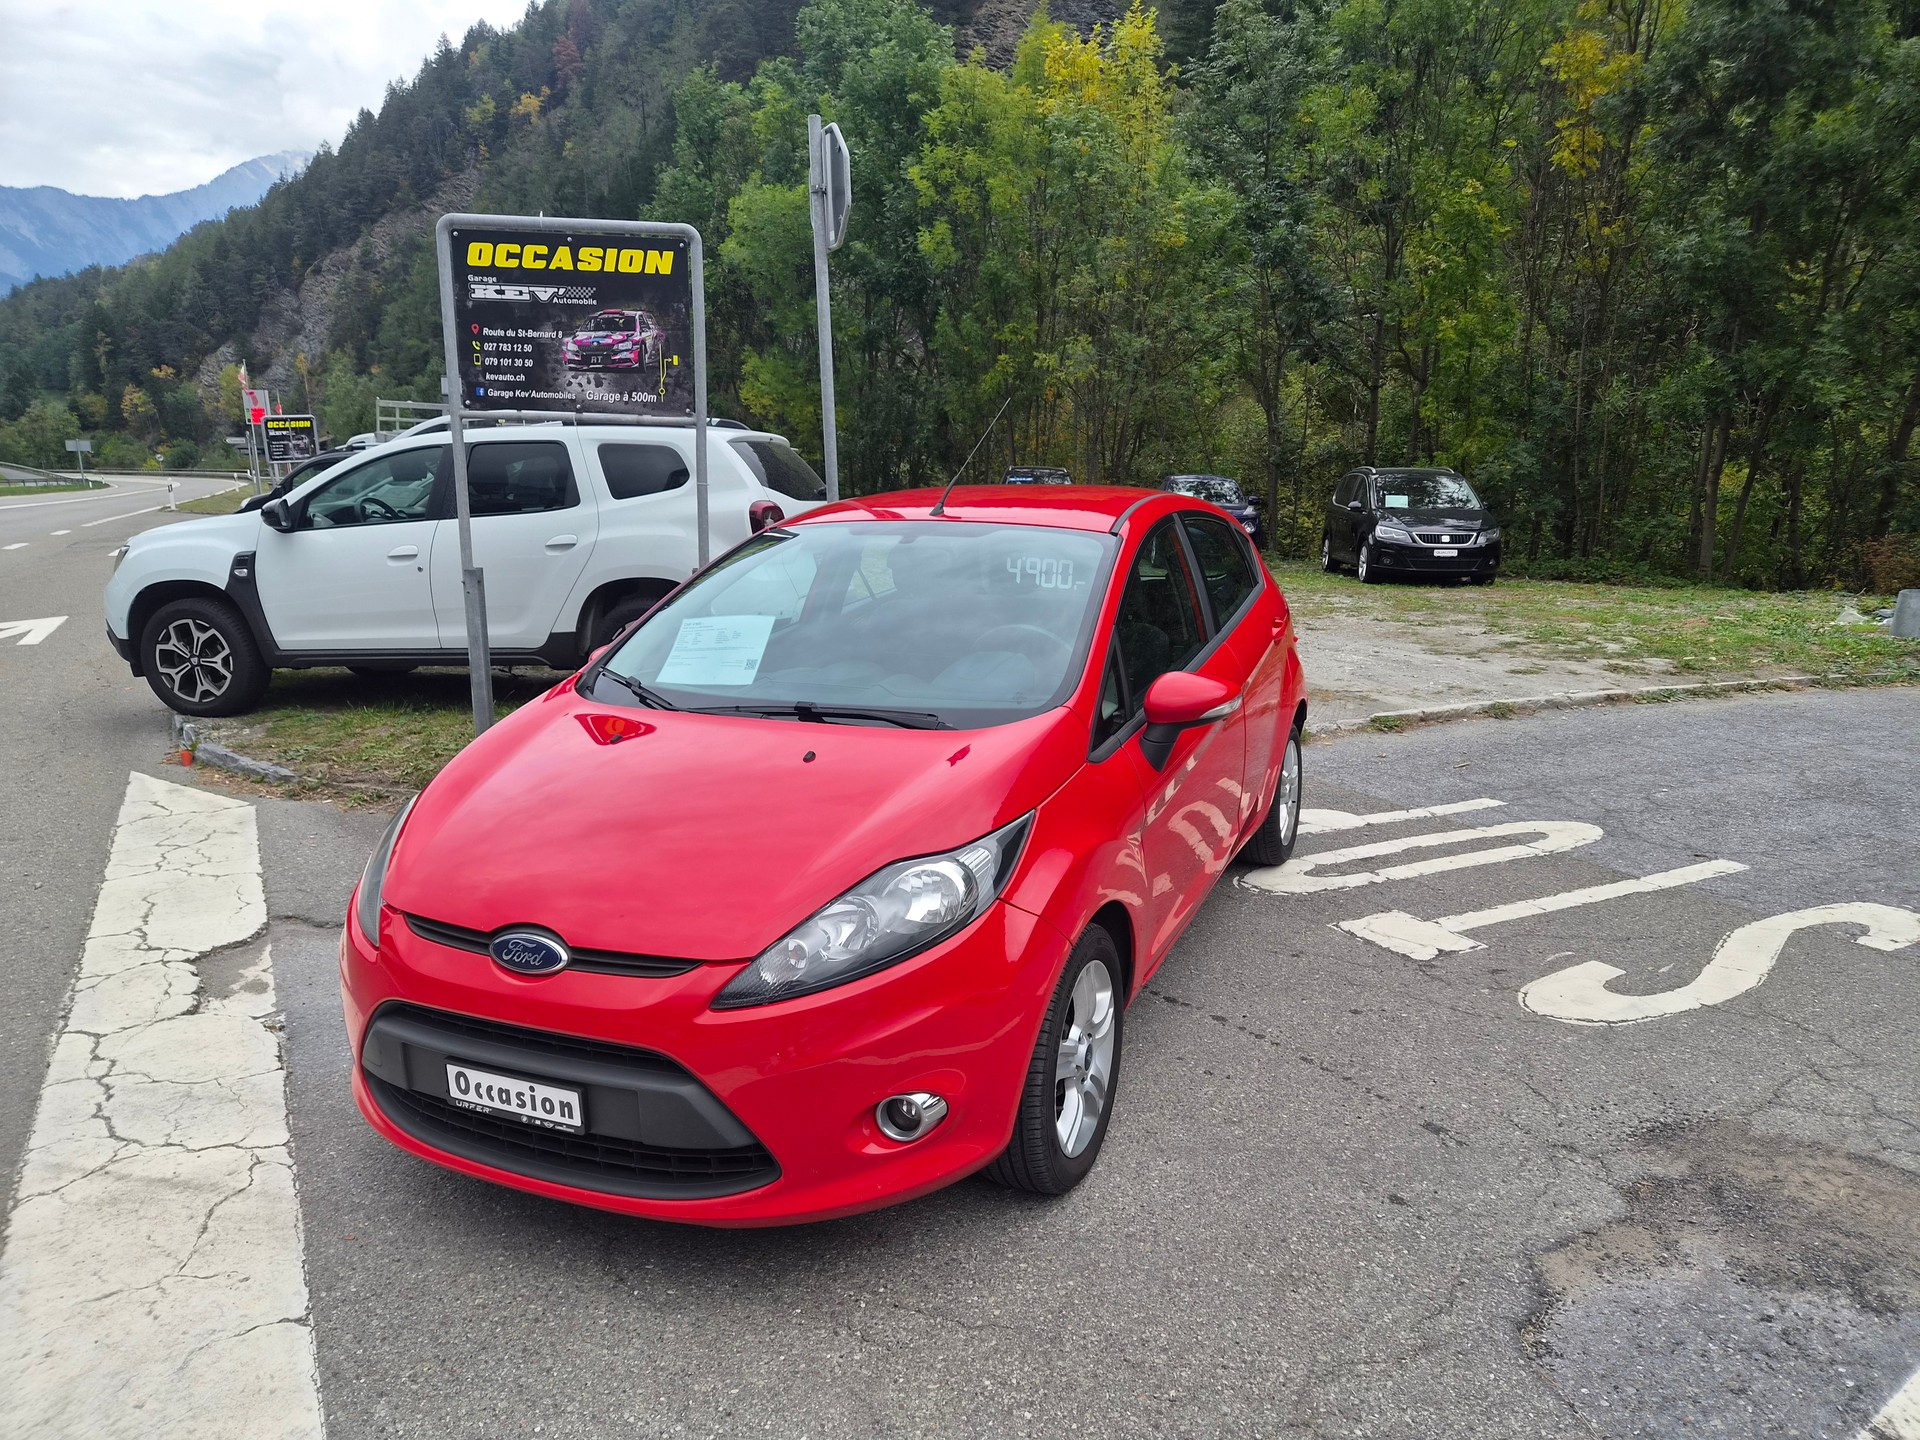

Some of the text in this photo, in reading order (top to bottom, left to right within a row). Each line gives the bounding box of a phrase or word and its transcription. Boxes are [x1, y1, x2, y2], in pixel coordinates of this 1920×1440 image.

[467, 242, 674, 275] OCCASION
[467, 274, 497, 284] Garage
[552, 297, 597, 305] Automobile
[482, 327, 563, 339] Route du St-Bernard 8
[483, 342, 533, 352] 027 783 12 50
[484, 357, 534, 367] 079 101 30 50
[485, 372, 526, 382] kevauto.ch
[487, 388, 576, 400] Garage Kev'Automobiles
[586, 390, 657, 403] Garage à 500m
[267, 420, 311, 428] OCCASION
[502, 940, 546, 966] Ford
[454, 1070, 574, 1120] Occasion
